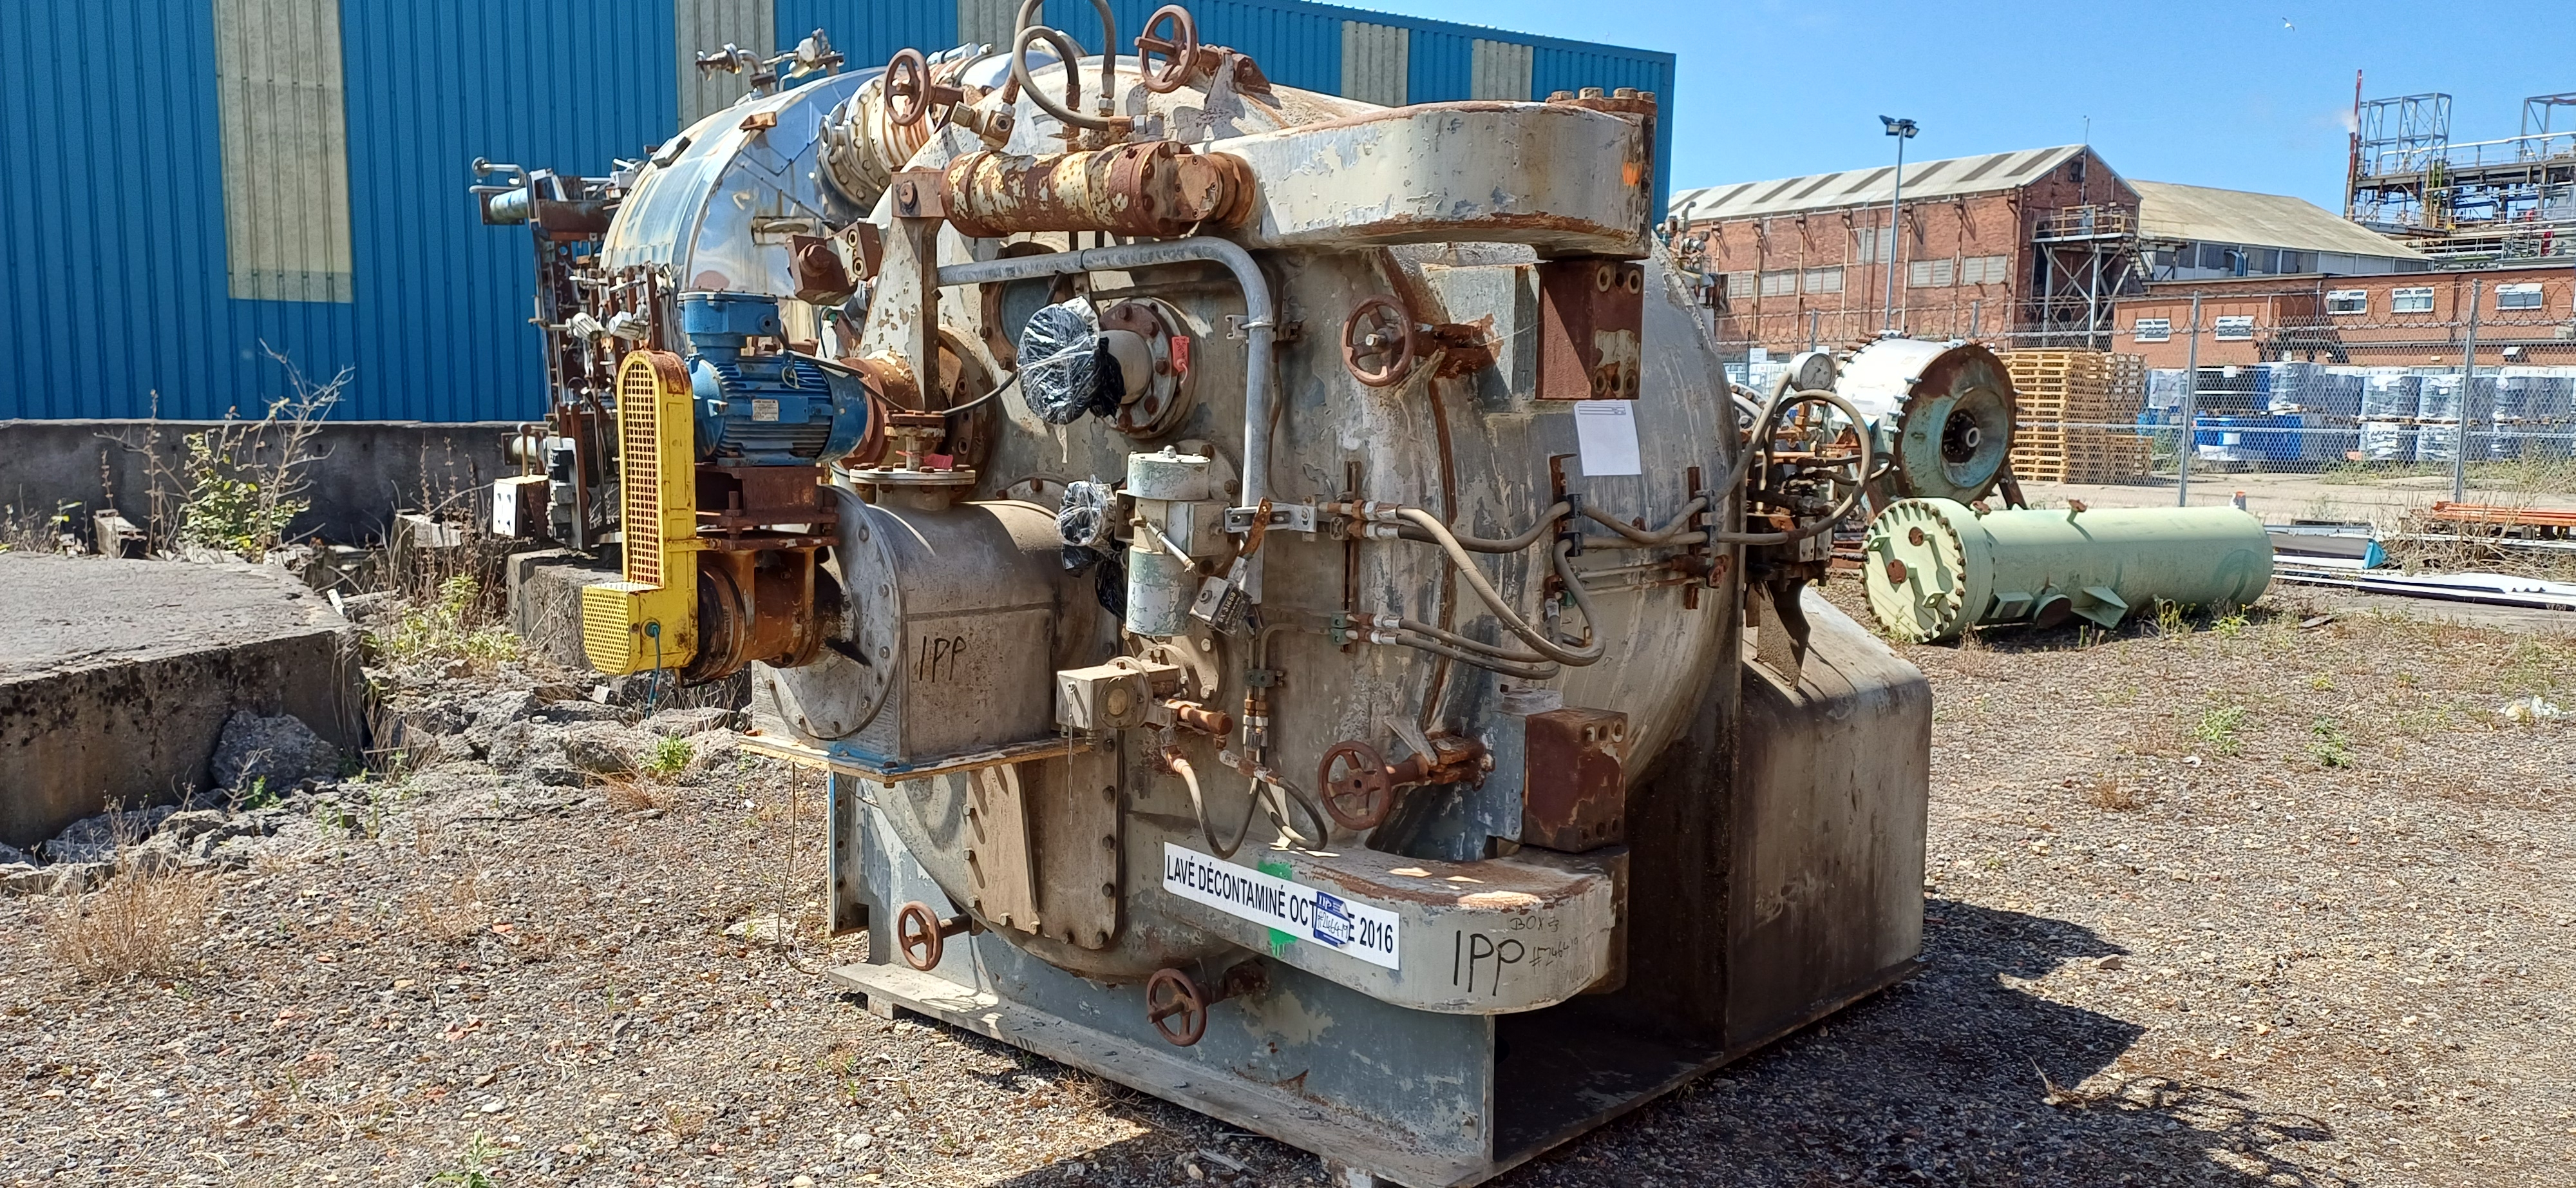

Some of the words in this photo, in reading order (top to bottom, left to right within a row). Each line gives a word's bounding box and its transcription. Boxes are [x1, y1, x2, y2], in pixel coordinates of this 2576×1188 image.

[919, 635, 967, 683] IPP
[1166, 854, 1195, 887] LAVÉ
[1198, 861, 1286, 919] DÉCONTAMINÉ
[1290, 894, 1356, 943] OCTE
[1359, 917, 1394, 953] 2016
[1510, 915, 1544, 931] BOX
[1453, 930, 1525, 996] IPP
